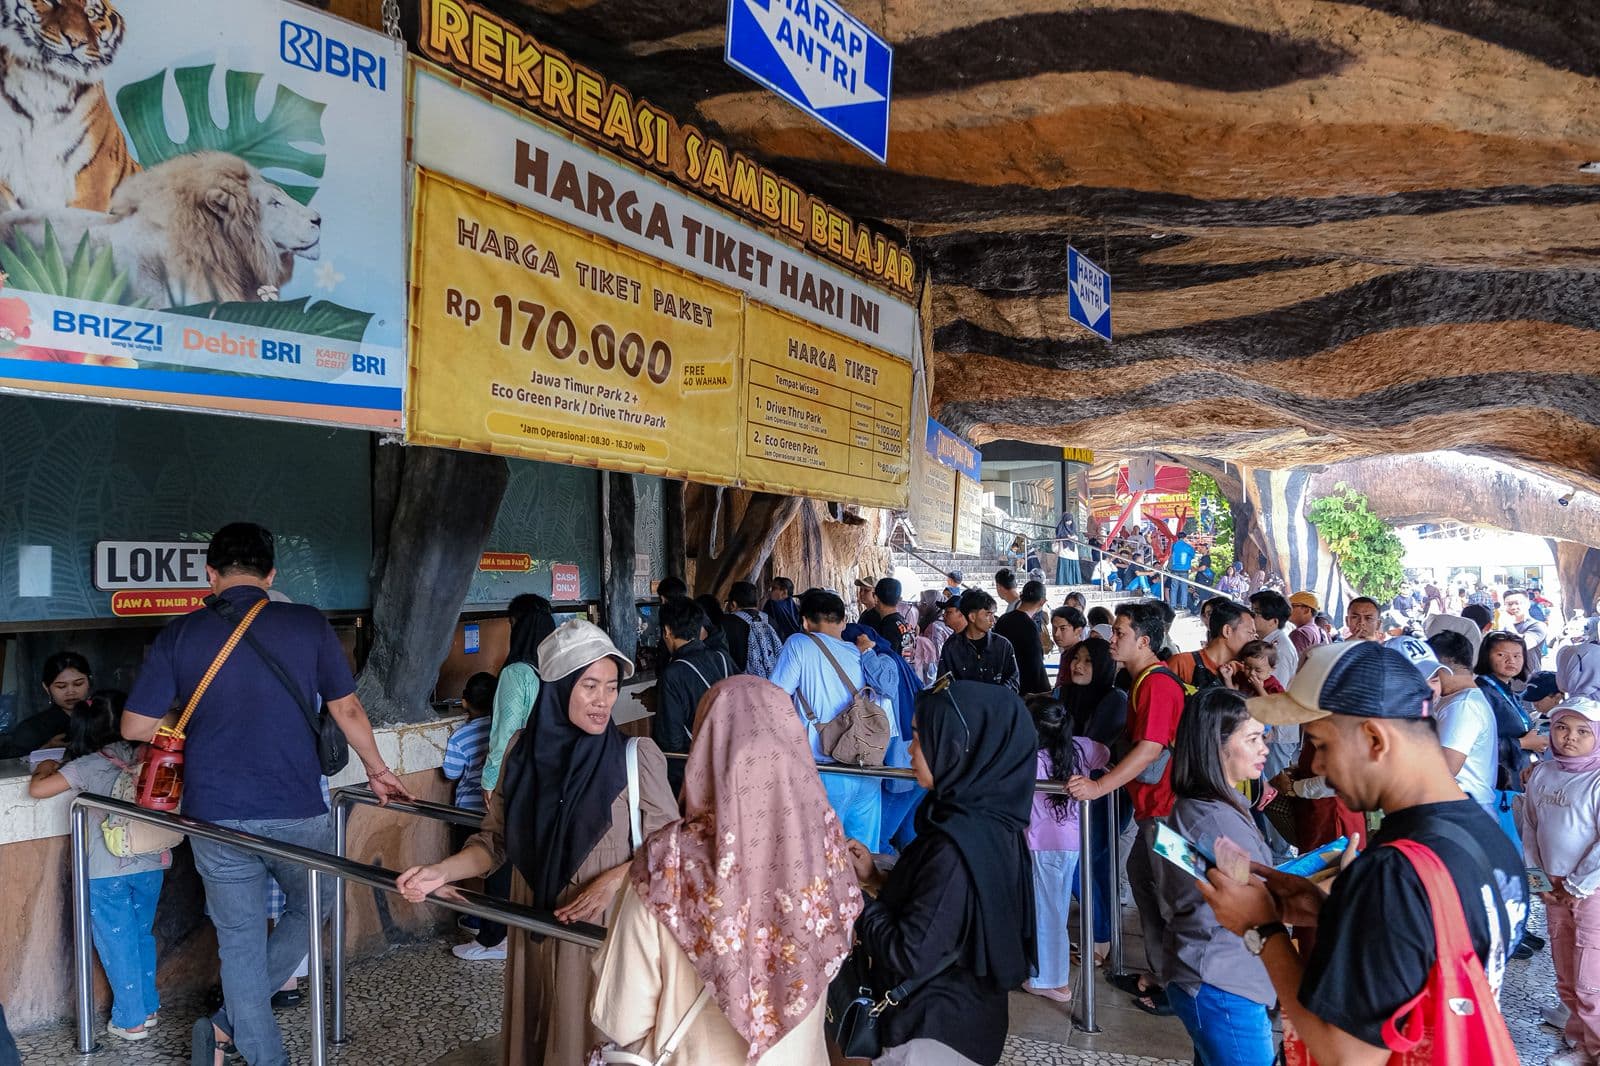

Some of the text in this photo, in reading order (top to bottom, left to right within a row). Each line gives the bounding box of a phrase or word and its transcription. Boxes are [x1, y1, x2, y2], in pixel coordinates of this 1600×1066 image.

[777, 0, 863, 58] ARAP
[326, 38, 386, 91] BRI
[776, 16, 857, 95] ANTRI
[430, 0, 916, 293] REKREASI SAMBIL BELAJAR
[514, 138, 880, 335] HARGA TIKET HARI INI
[457, 217, 713, 328] HARGA TIKET PAKET
[1078, 261, 1102, 290] HARAP
[1080, 283, 1102, 312] ANTRI
[53, 309, 163, 345] BRIZZI
[446, 288, 673, 385] Rp 170.000
[182, 327, 302, 364] Debit BRI
[315, 348, 349, 361] KARTU
[315, 359, 347, 369] DEBIT
[352, 354, 386, 376] BRI
[684, 365, 705, 376] FREE
[788, 337, 879, 386] HARGA TIKET
[530, 370, 561, 388] Jawa
[564, 377, 594, 396] Timur
[596, 385, 622, 402] Park
[623, 391, 631, 404] 2
[683, 376, 727, 386] 40 WAHANA
[775, 374, 819, 396] Tempat Wisata
[491, 382, 513, 399] Eco
[516, 387, 552, 407] Green
[554, 395, 580, 413] Park
[589, 403, 616, 419] Drive
[618, 408, 642, 424] Thru
[643, 413, 666, 428] Park
[756, 396, 822, 425] 1. Drive Thru Park
[540, 427, 587, 443] Operasional
[590, 435, 611, 447] 08.30
[615, 439, 633, 450] 16.30
[633, 441, 646, 452] wib
[753, 430, 819, 455] 2. Eco Green Park
[555, 572, 577, 582] CASH
[555, 583, 577, 592] ONLY
[116, 597, 206, 609] JAWA TIMUR PA
